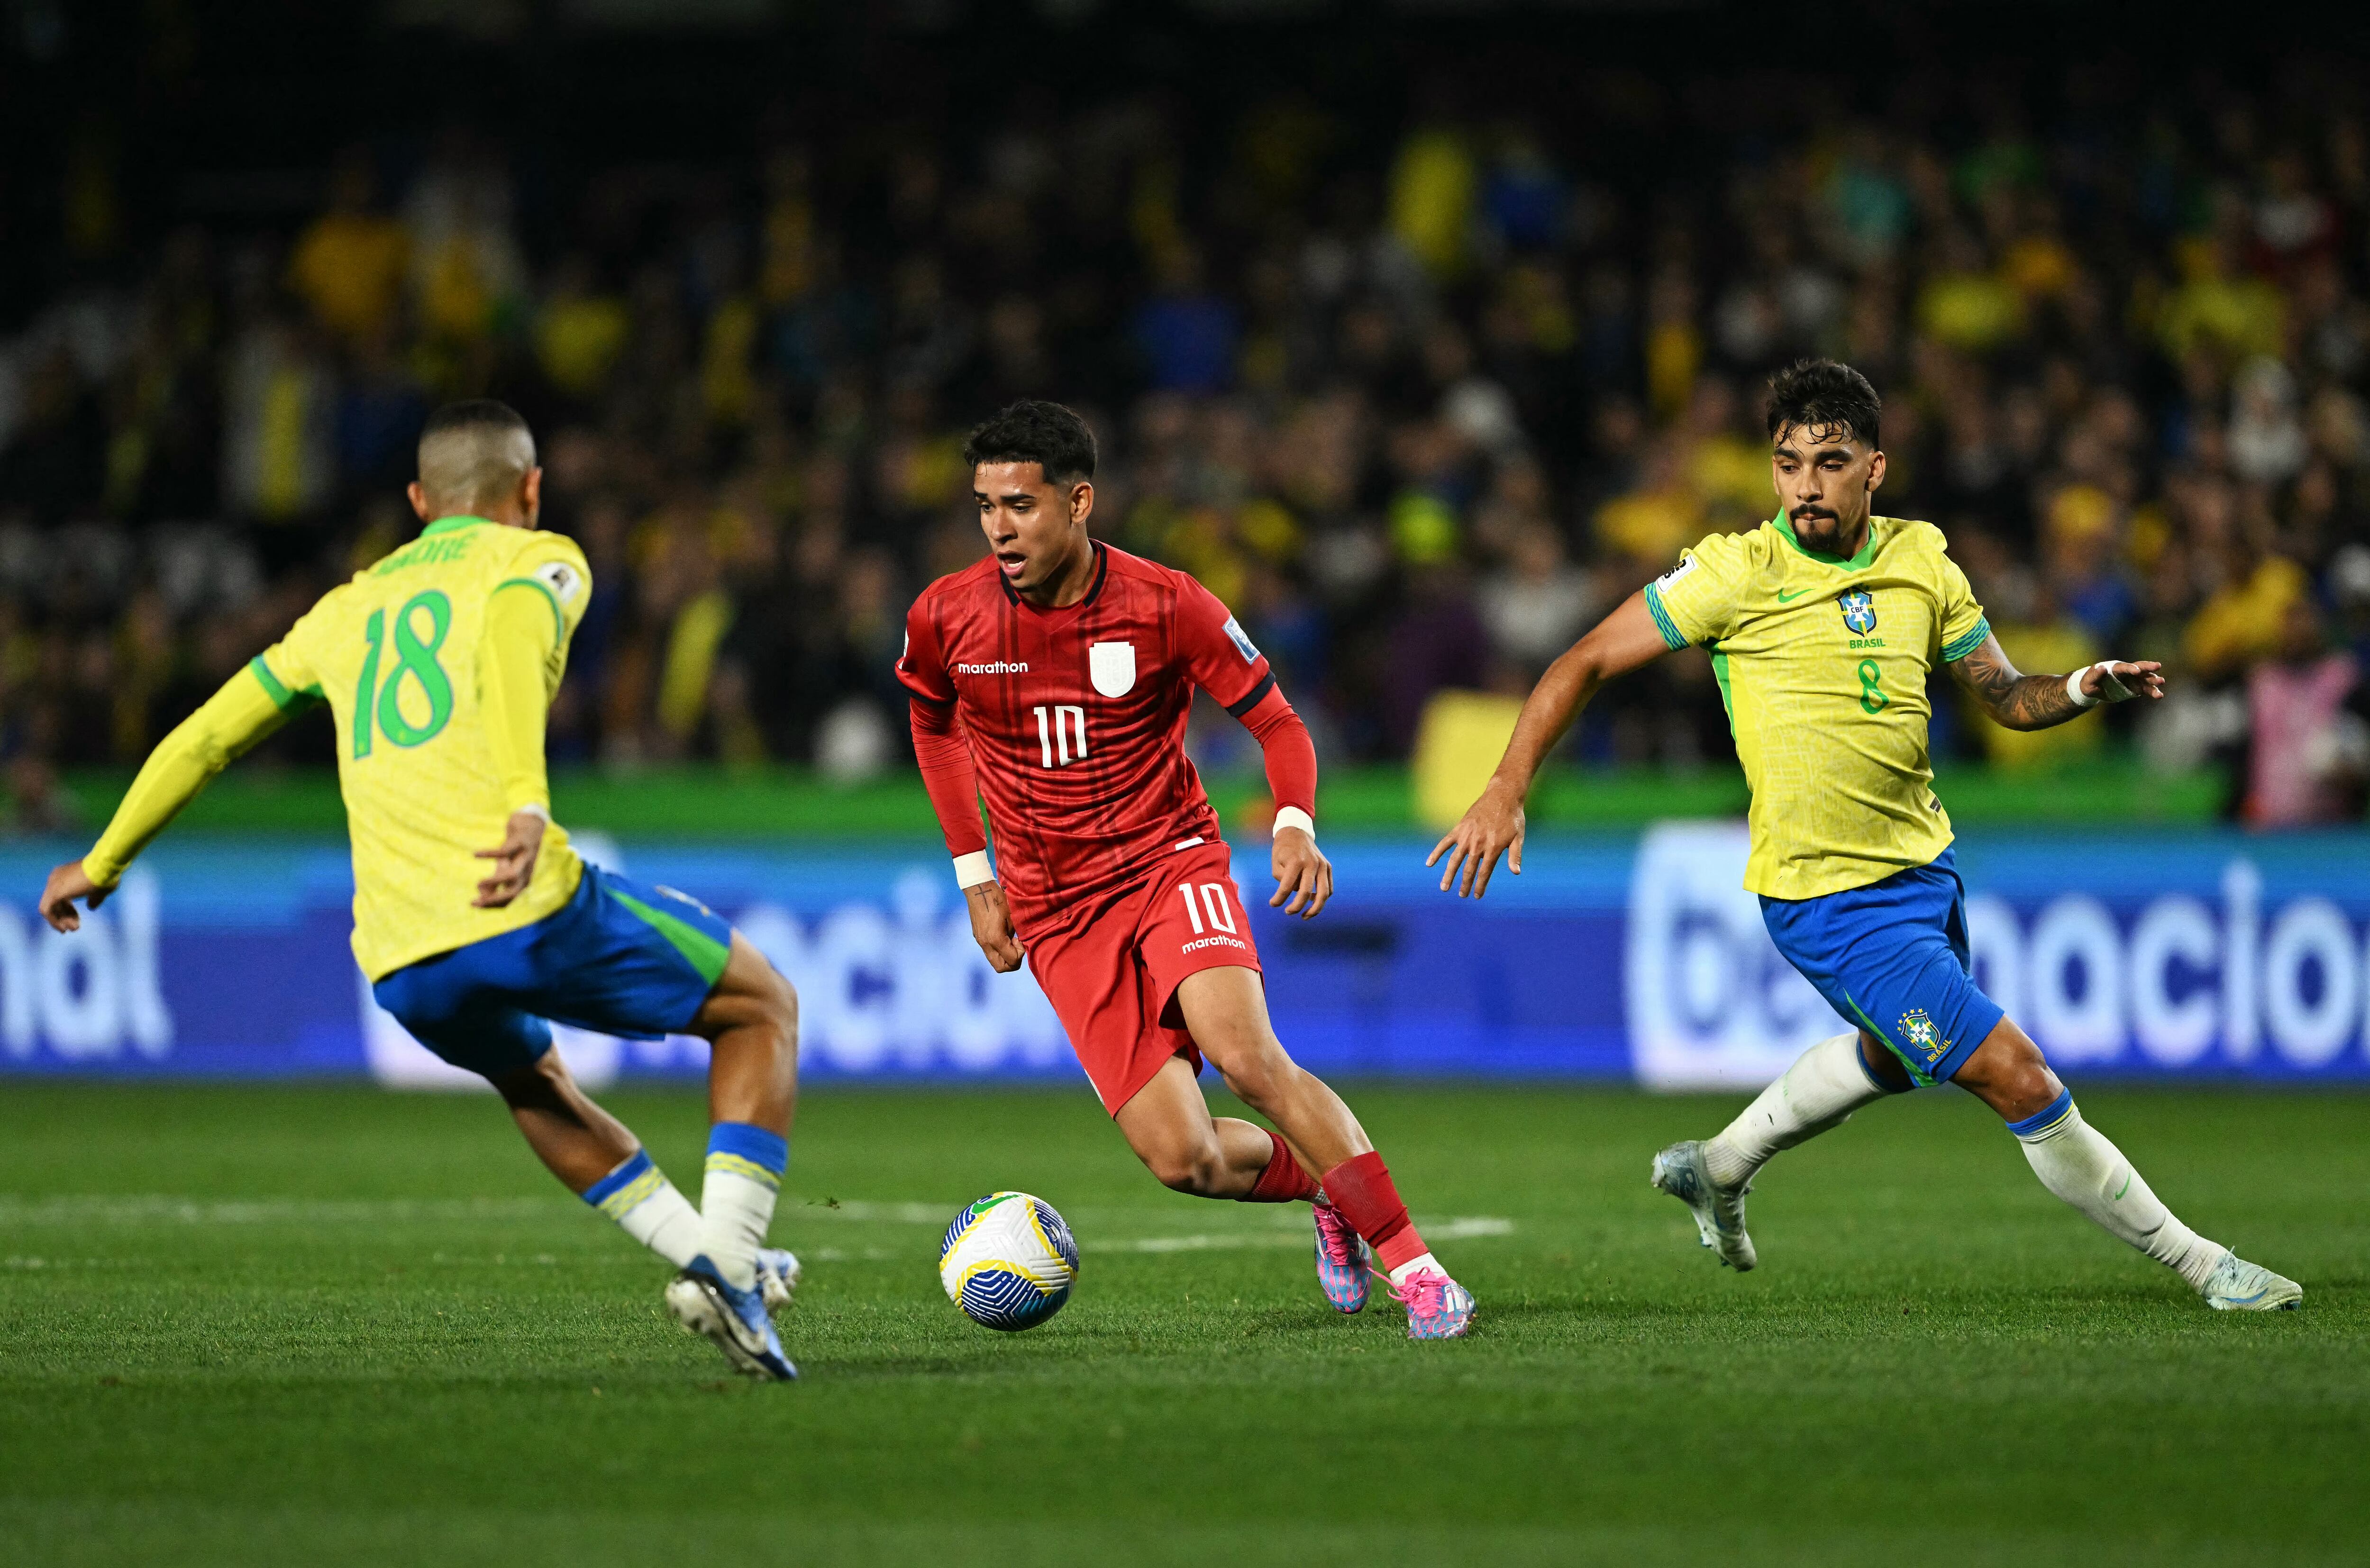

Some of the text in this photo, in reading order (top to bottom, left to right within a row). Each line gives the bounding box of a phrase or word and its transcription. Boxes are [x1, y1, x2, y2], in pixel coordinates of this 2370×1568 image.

[1849, 638, 1886, 649] BRASIL
[353, 589, 453, 761] 18
[958, 661, 1028, 674] marathon
[1858, 659, 1889, 715] 8
[1033, 706, 1087, 768] 10
[1178, 882, 1237, 934] 10
[1182, 935, 1246, 954] marathon
[1966, 859, 2370, 1066] nacio
[1915, 1028, 1925, 1038] CBF
[1927, 1039, 1951, 1062] BRASIL
